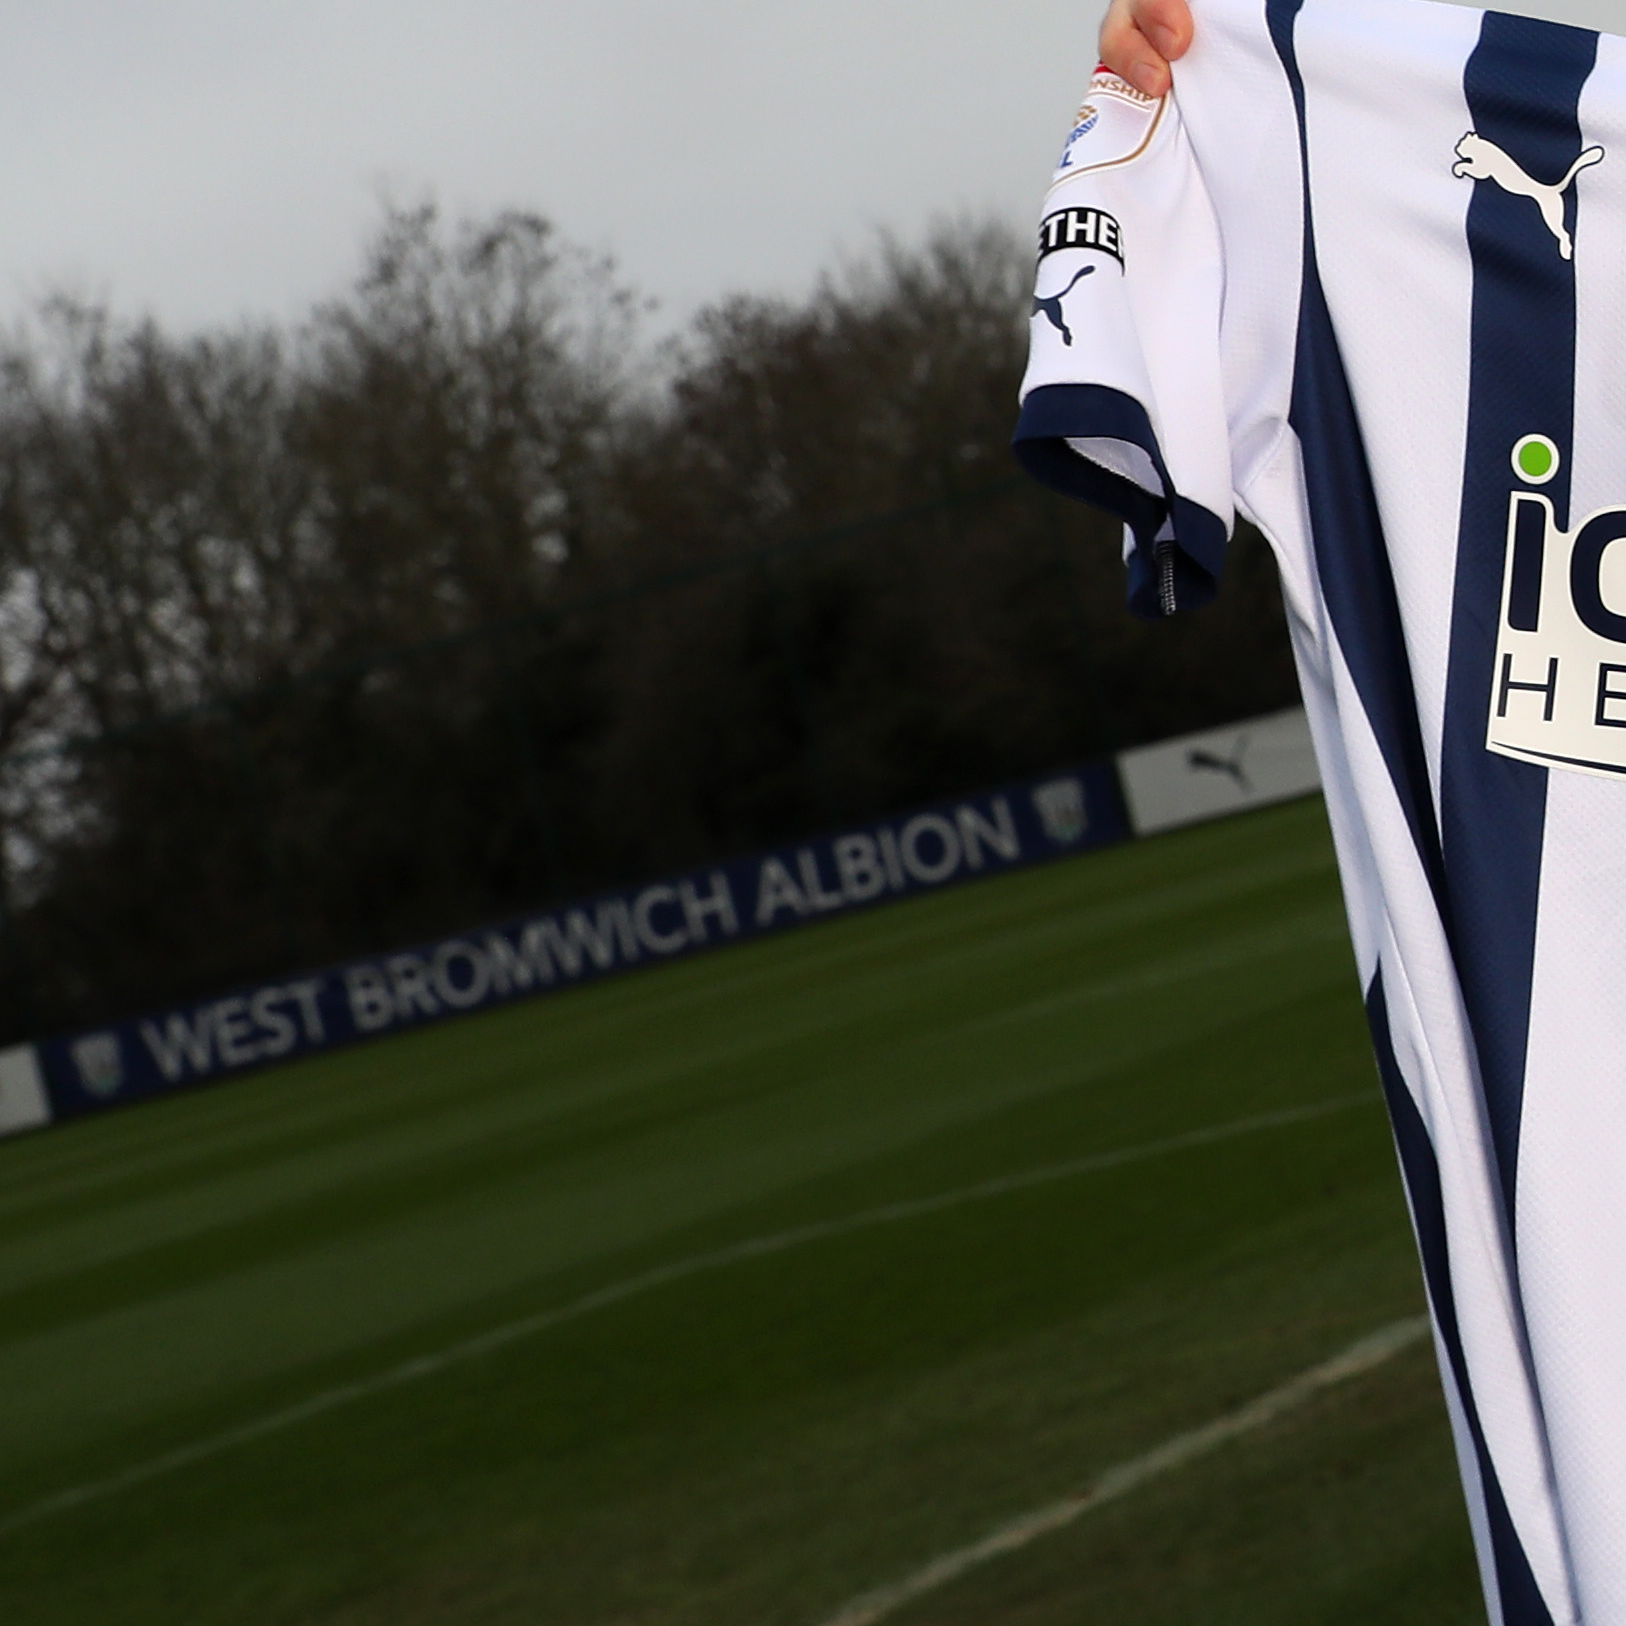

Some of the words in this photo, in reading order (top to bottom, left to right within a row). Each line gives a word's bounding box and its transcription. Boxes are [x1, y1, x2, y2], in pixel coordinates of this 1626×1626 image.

[140, 980, 328, 1082] WEST
[343, 873, 738, 1031] BROMWICH
[754, 797, 1021, 927] ALBION
